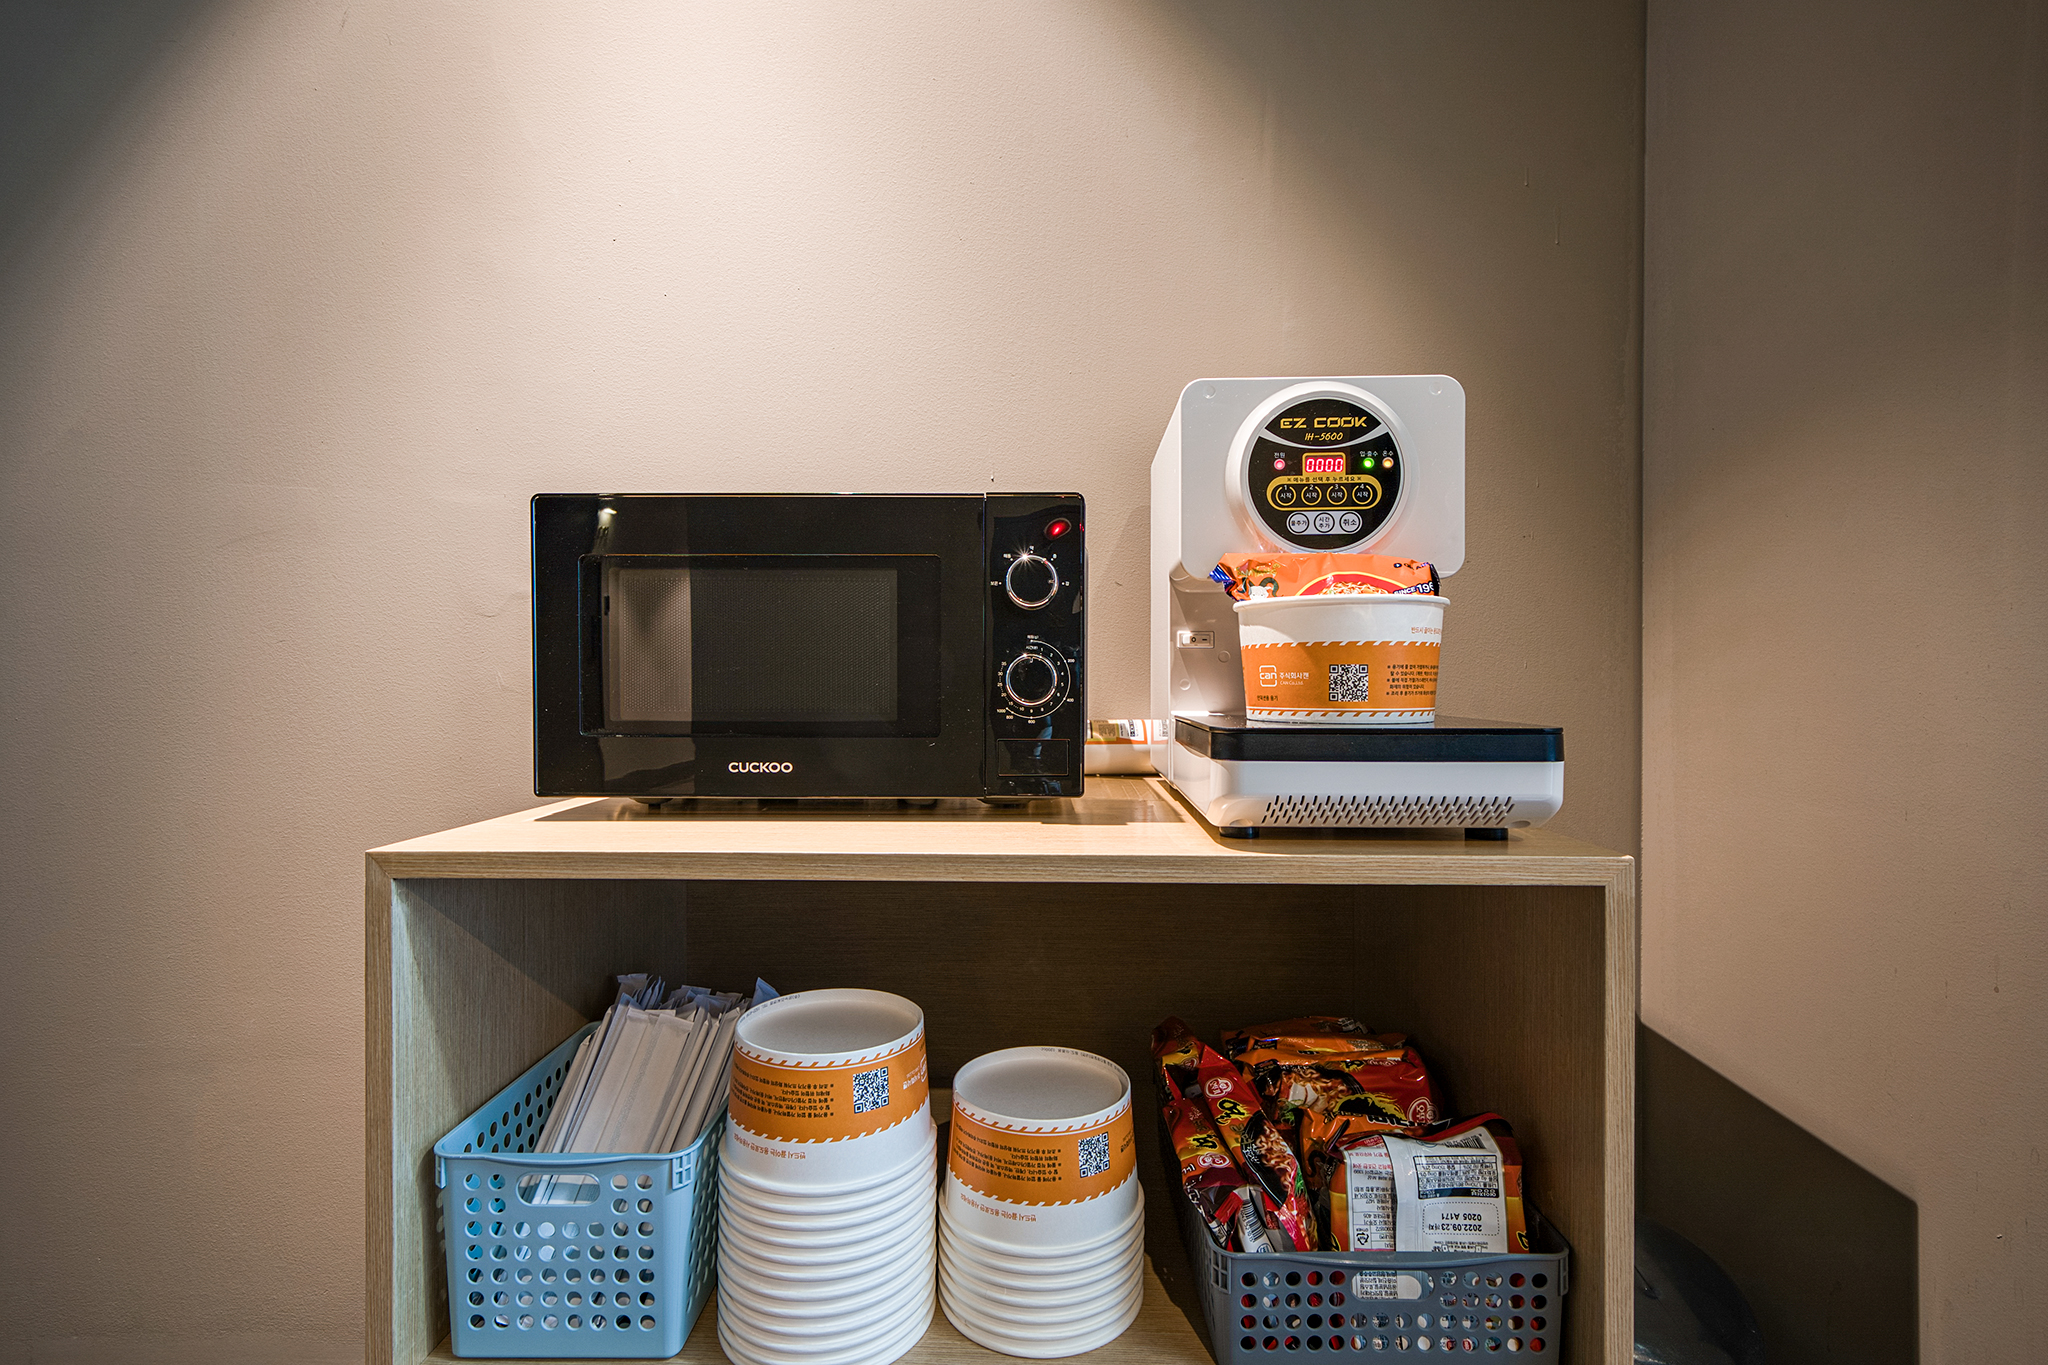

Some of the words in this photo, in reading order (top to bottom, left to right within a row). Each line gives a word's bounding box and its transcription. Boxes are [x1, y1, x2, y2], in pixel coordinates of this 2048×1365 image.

[1281, 418, 1306, 428] EZ
[1314, 417, 1367, 428] COOK
[1306, 458, 1343, 472] 0000
[728, 762, 793, 773] CUCKOO
[788, 1151, 806, 1159] 반드시
[1019, 1214, 1036, 1222] 반드시
[1462, 1213, 1482, 1221] 0205
